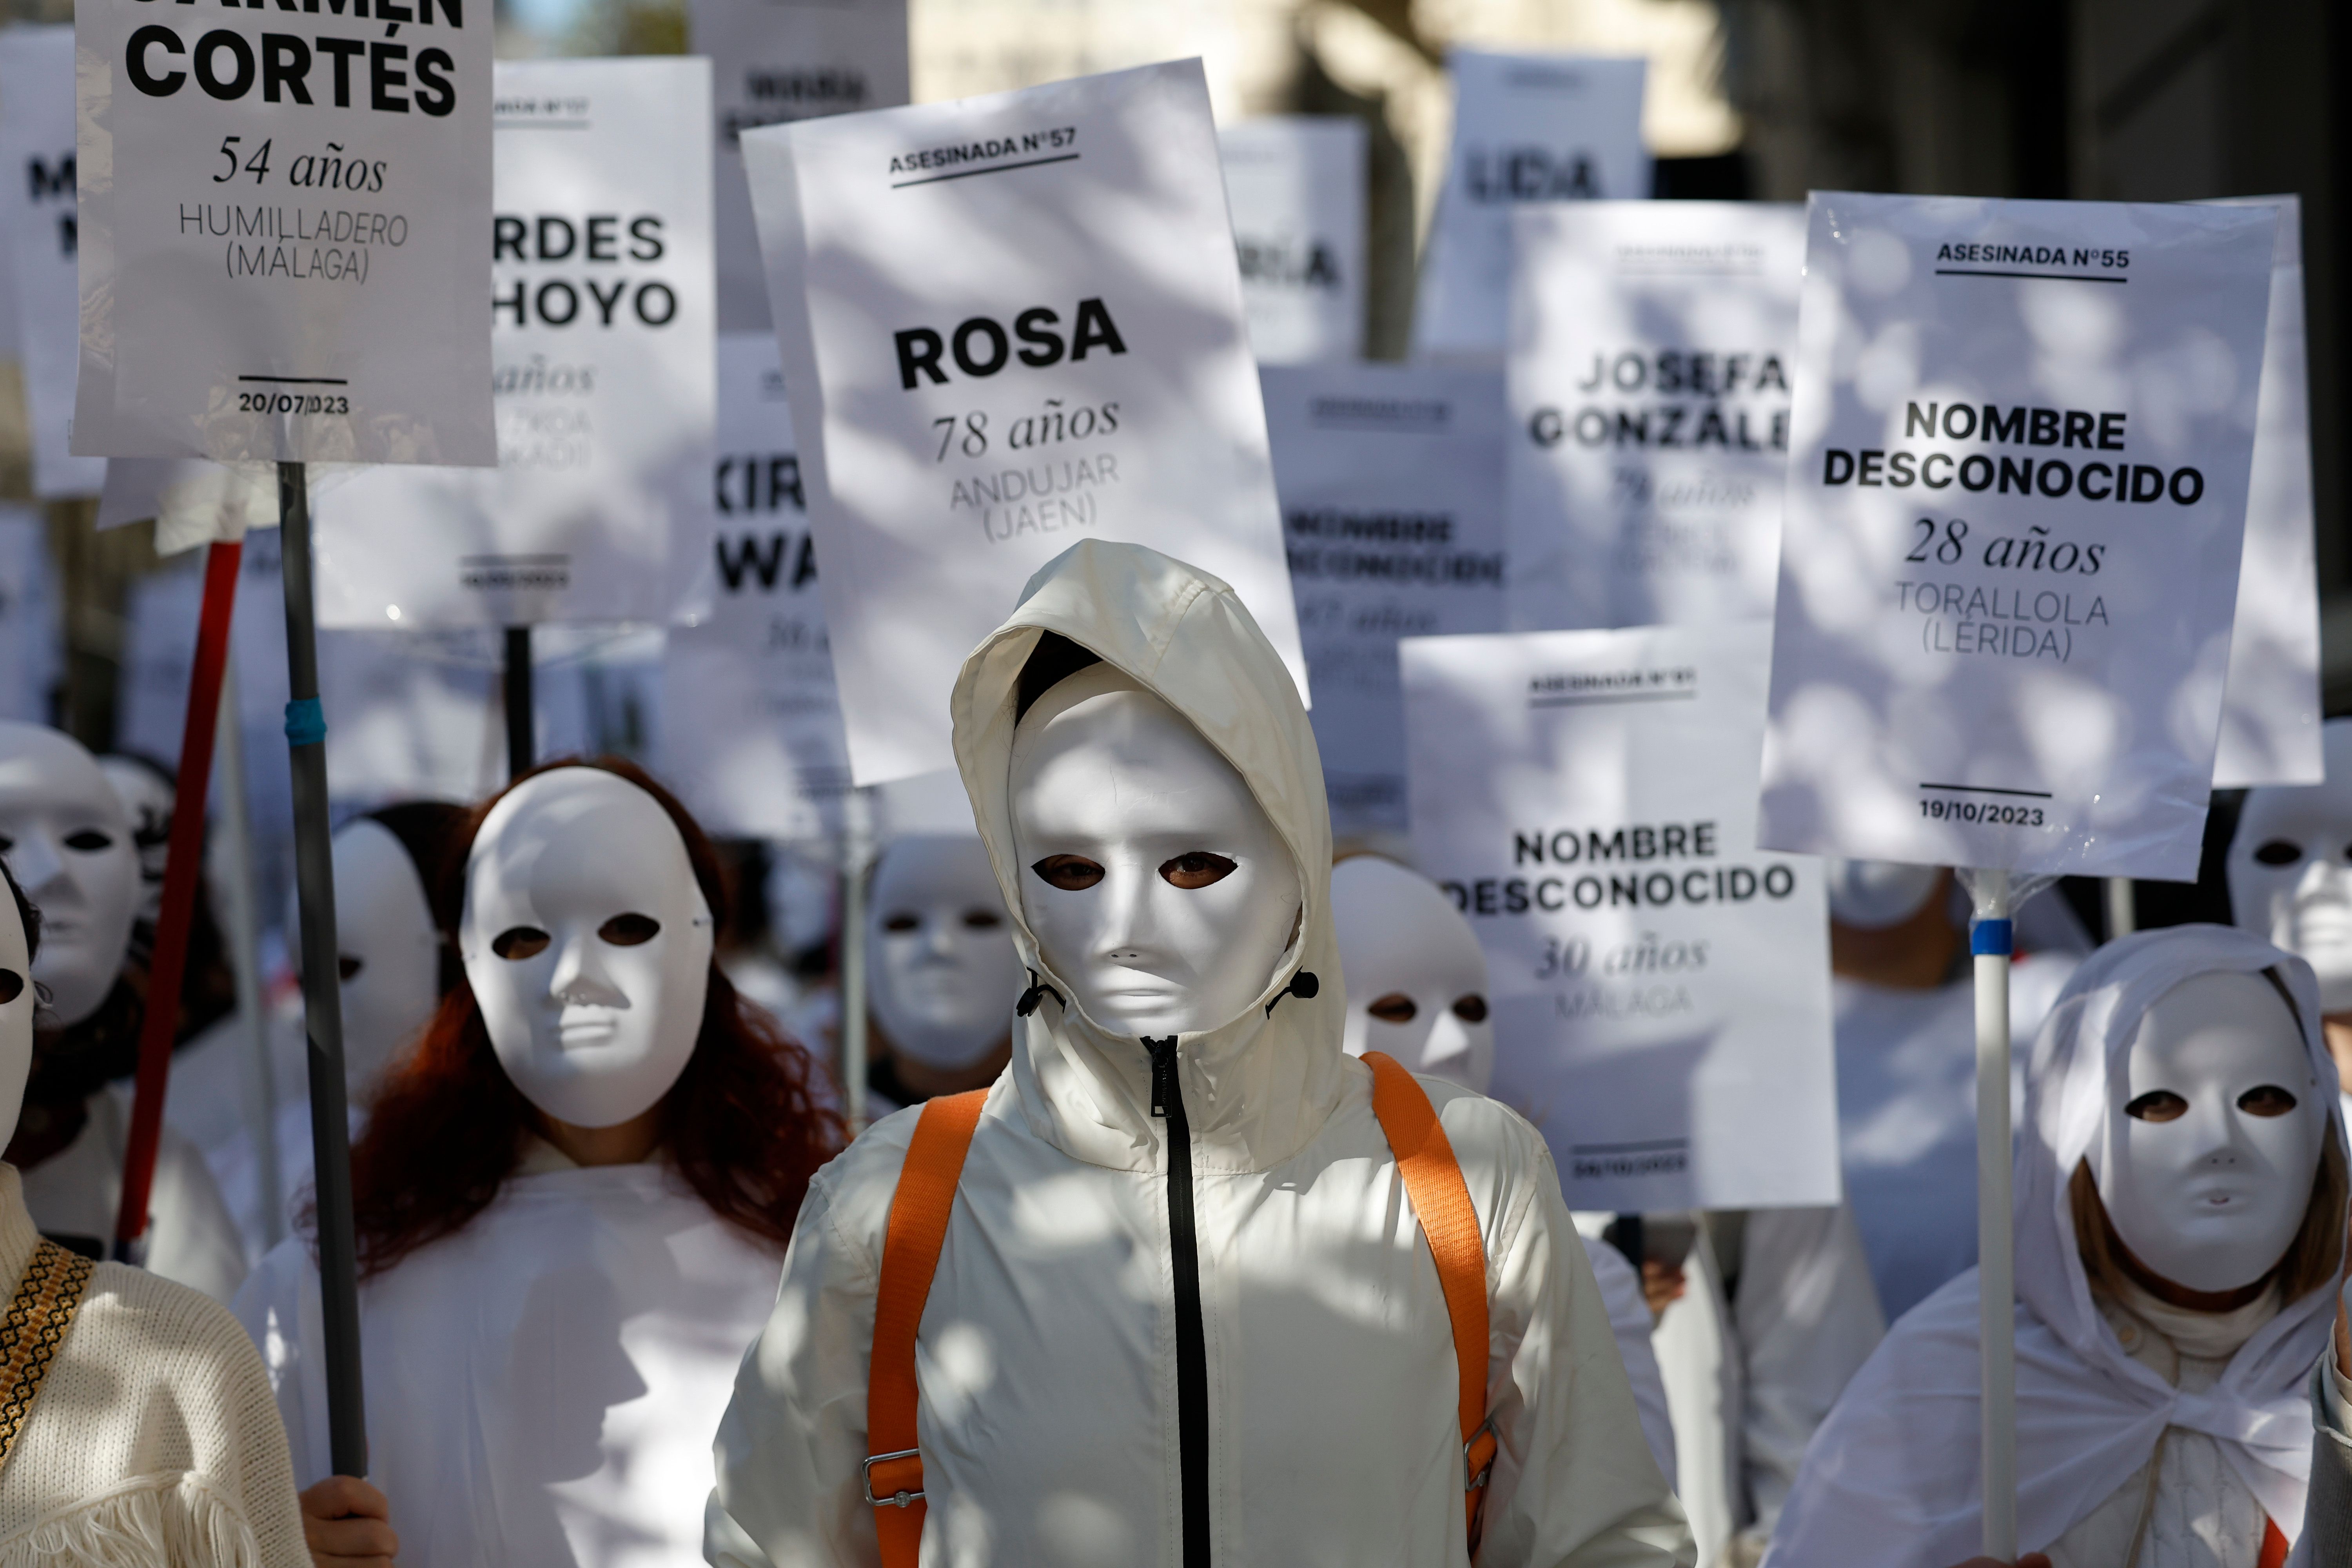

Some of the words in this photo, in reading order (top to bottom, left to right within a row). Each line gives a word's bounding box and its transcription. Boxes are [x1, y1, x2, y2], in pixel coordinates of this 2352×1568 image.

[125, 24, 456, 117] CORTÉS
[214, 136, 272, 184] 54
[289, 142, 387, 193] años
[890, 137, 1018, 172] ASESINADA
[1021, 126, 1076, 151] Nº57
[180, 203, 408, 247] HUMILLADERO
[226, 234, 369, 285] (MÁLAGA)
[1937, 243, 2067, 266] ASESINADA
[2073, 249, 2130, 268] Nº55
[894, 297, 1128, 391] ROSA
[1582, 351, 1788, 394] JOSEFA
[933, 412, 989, 462] 78
[1009, 400, 1120, 450] años
[1904, 401, 2127, 451] NOMBRE
[950, 454, 1120, 510] ANDUJAR
[1823, 449, 2205, 506] DESCONOCIDO
[1904, 517, 1969, 564] 28
[1982, 525, 2107, 575] años
[1895, 581, 2110, 627] TORALLOLA
[1921, 608, 2074, 662] (LÉRIDA)
[1919, 799, 2044, 826] 19/10/2023
[1513, 821, 1717, 866] NOMBRE
[1604, 929, 1709, 974] años
